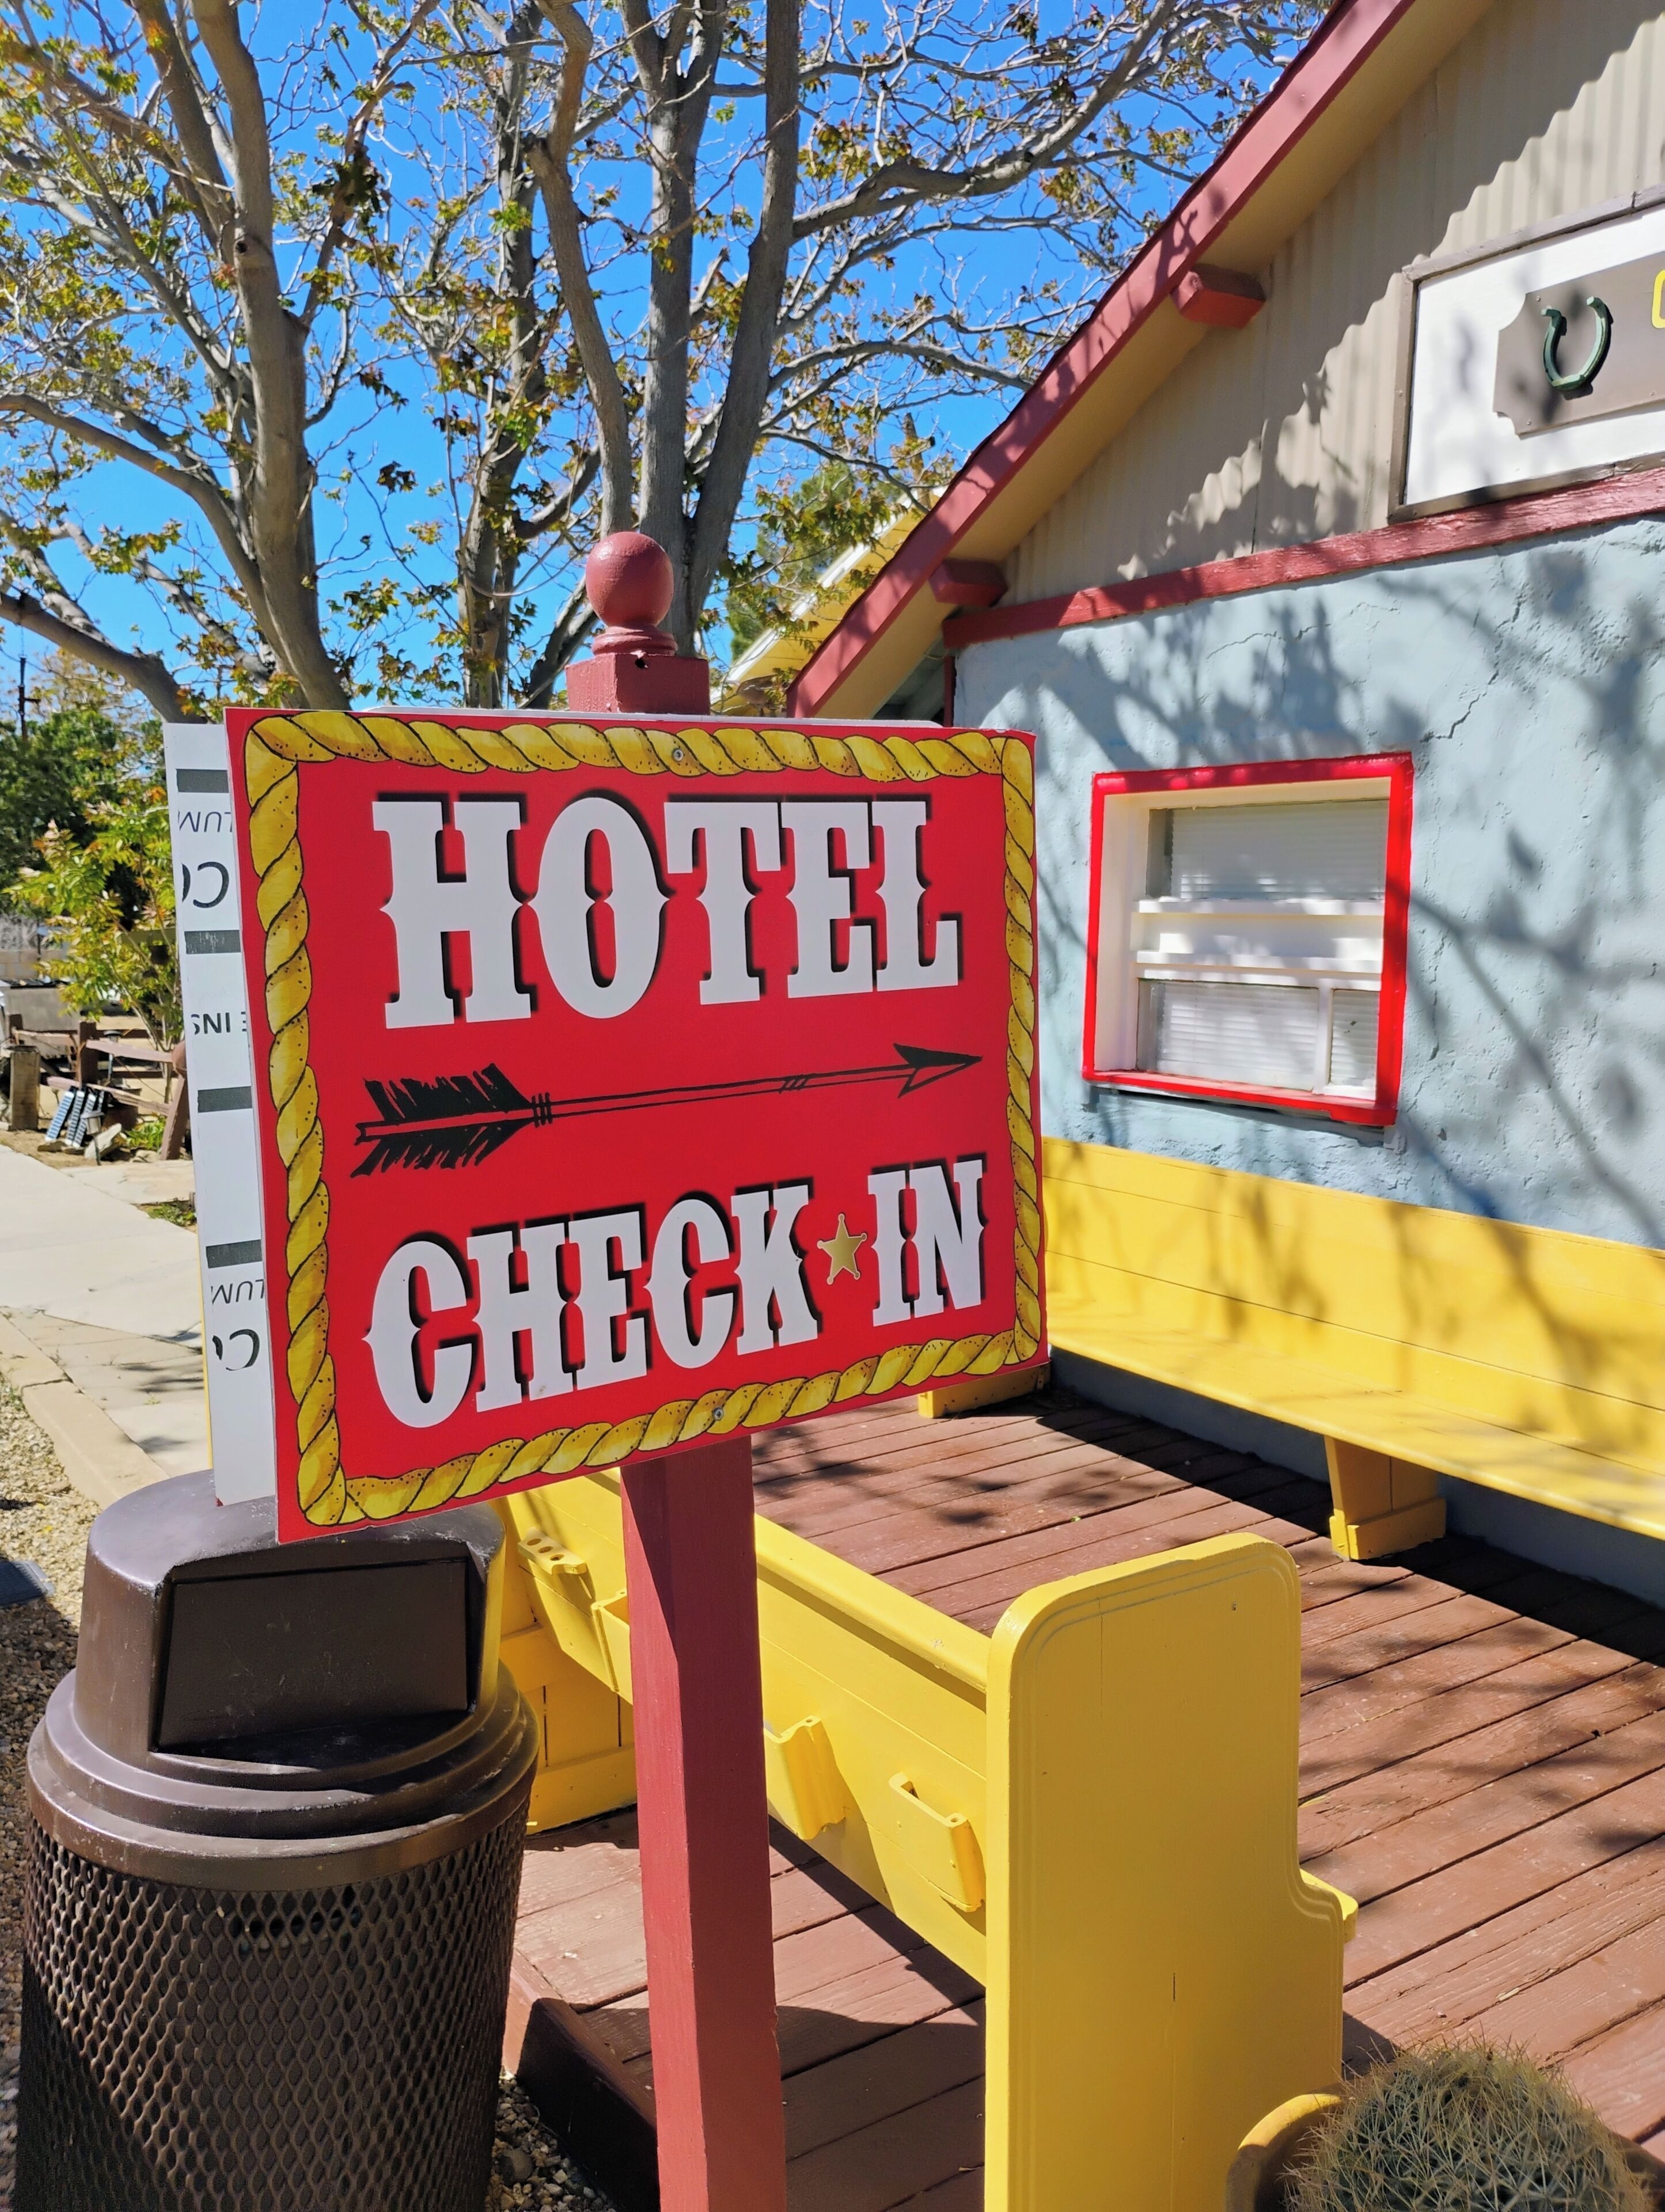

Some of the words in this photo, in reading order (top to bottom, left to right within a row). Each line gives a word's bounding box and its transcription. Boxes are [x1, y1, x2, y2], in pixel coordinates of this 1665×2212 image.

[373, 791, 958, 1029] HOTEL
[362, 1180, 820, 1429] CHECK
[867, 1154, 988, 1327] IN
